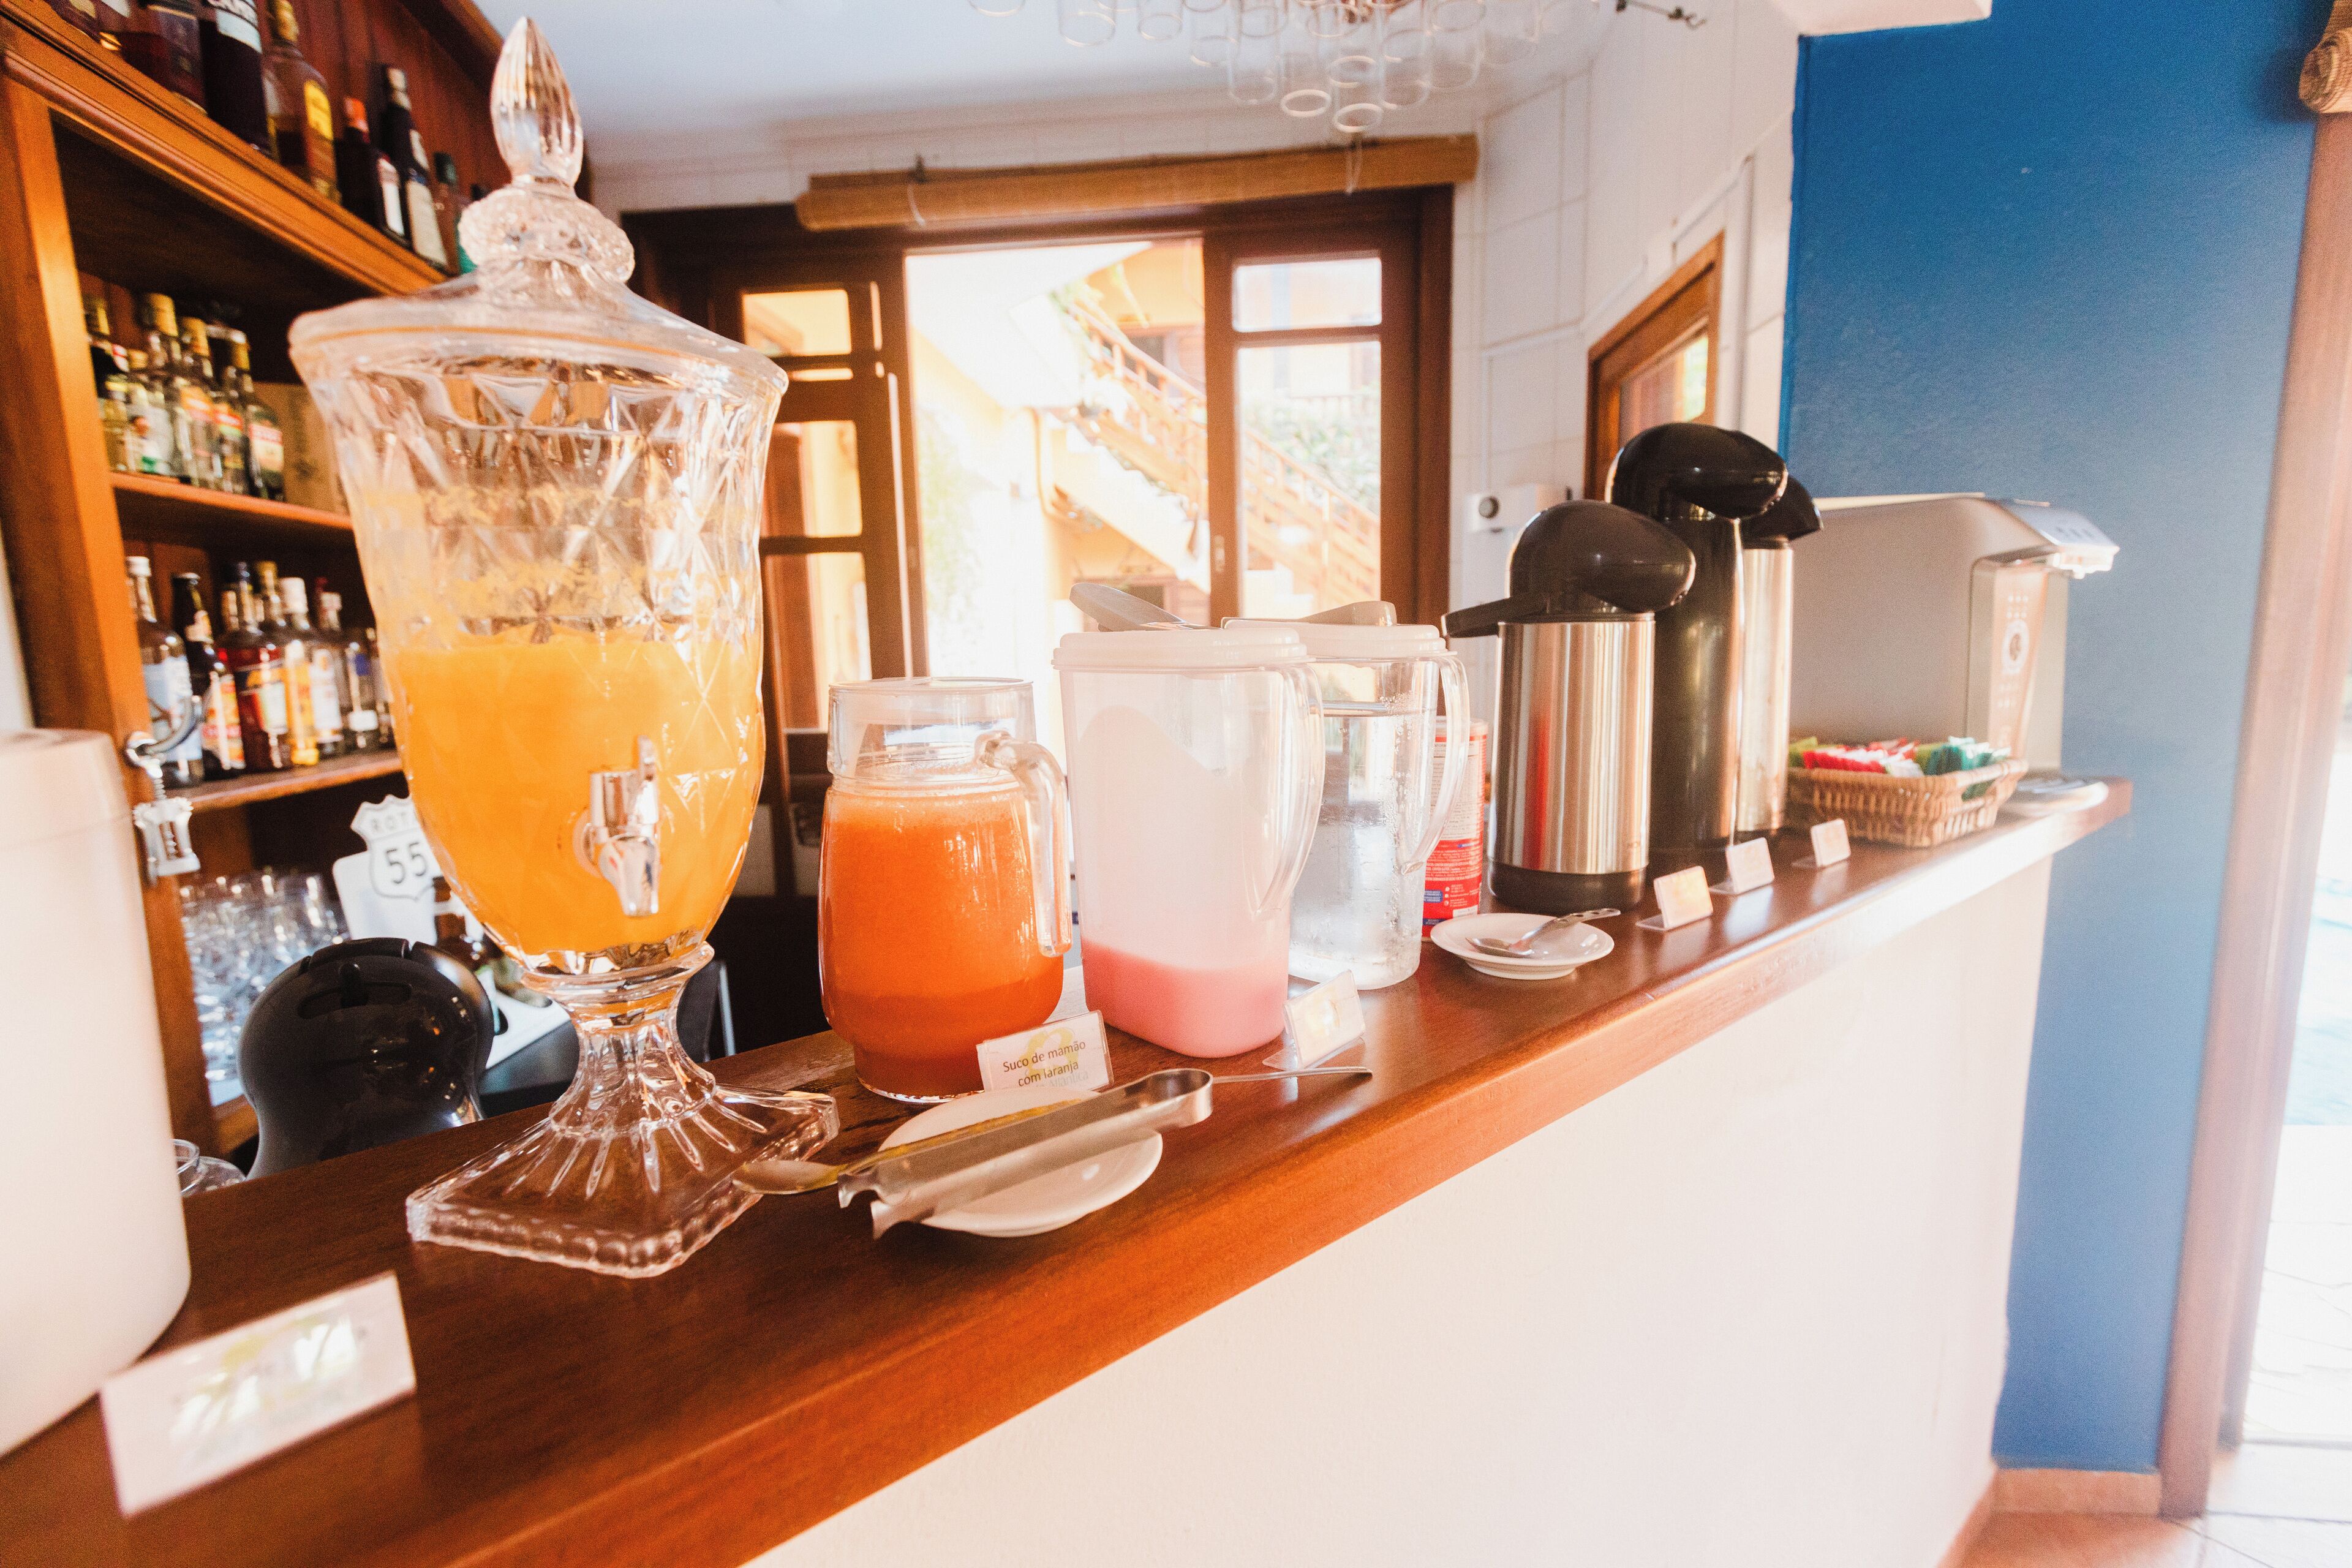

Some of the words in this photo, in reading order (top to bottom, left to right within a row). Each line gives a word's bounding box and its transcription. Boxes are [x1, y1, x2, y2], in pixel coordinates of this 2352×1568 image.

[386, 842, 428, 884] 55
[1003, 1058, 1029, 1072] Suco
[1031, 1052, 1045, 1064] de
[1047, 1040, 1086, 1059] mamão
[1018, 1072, 1041, 1087] com
[1043, 1061, 1079, 1079] laranja
